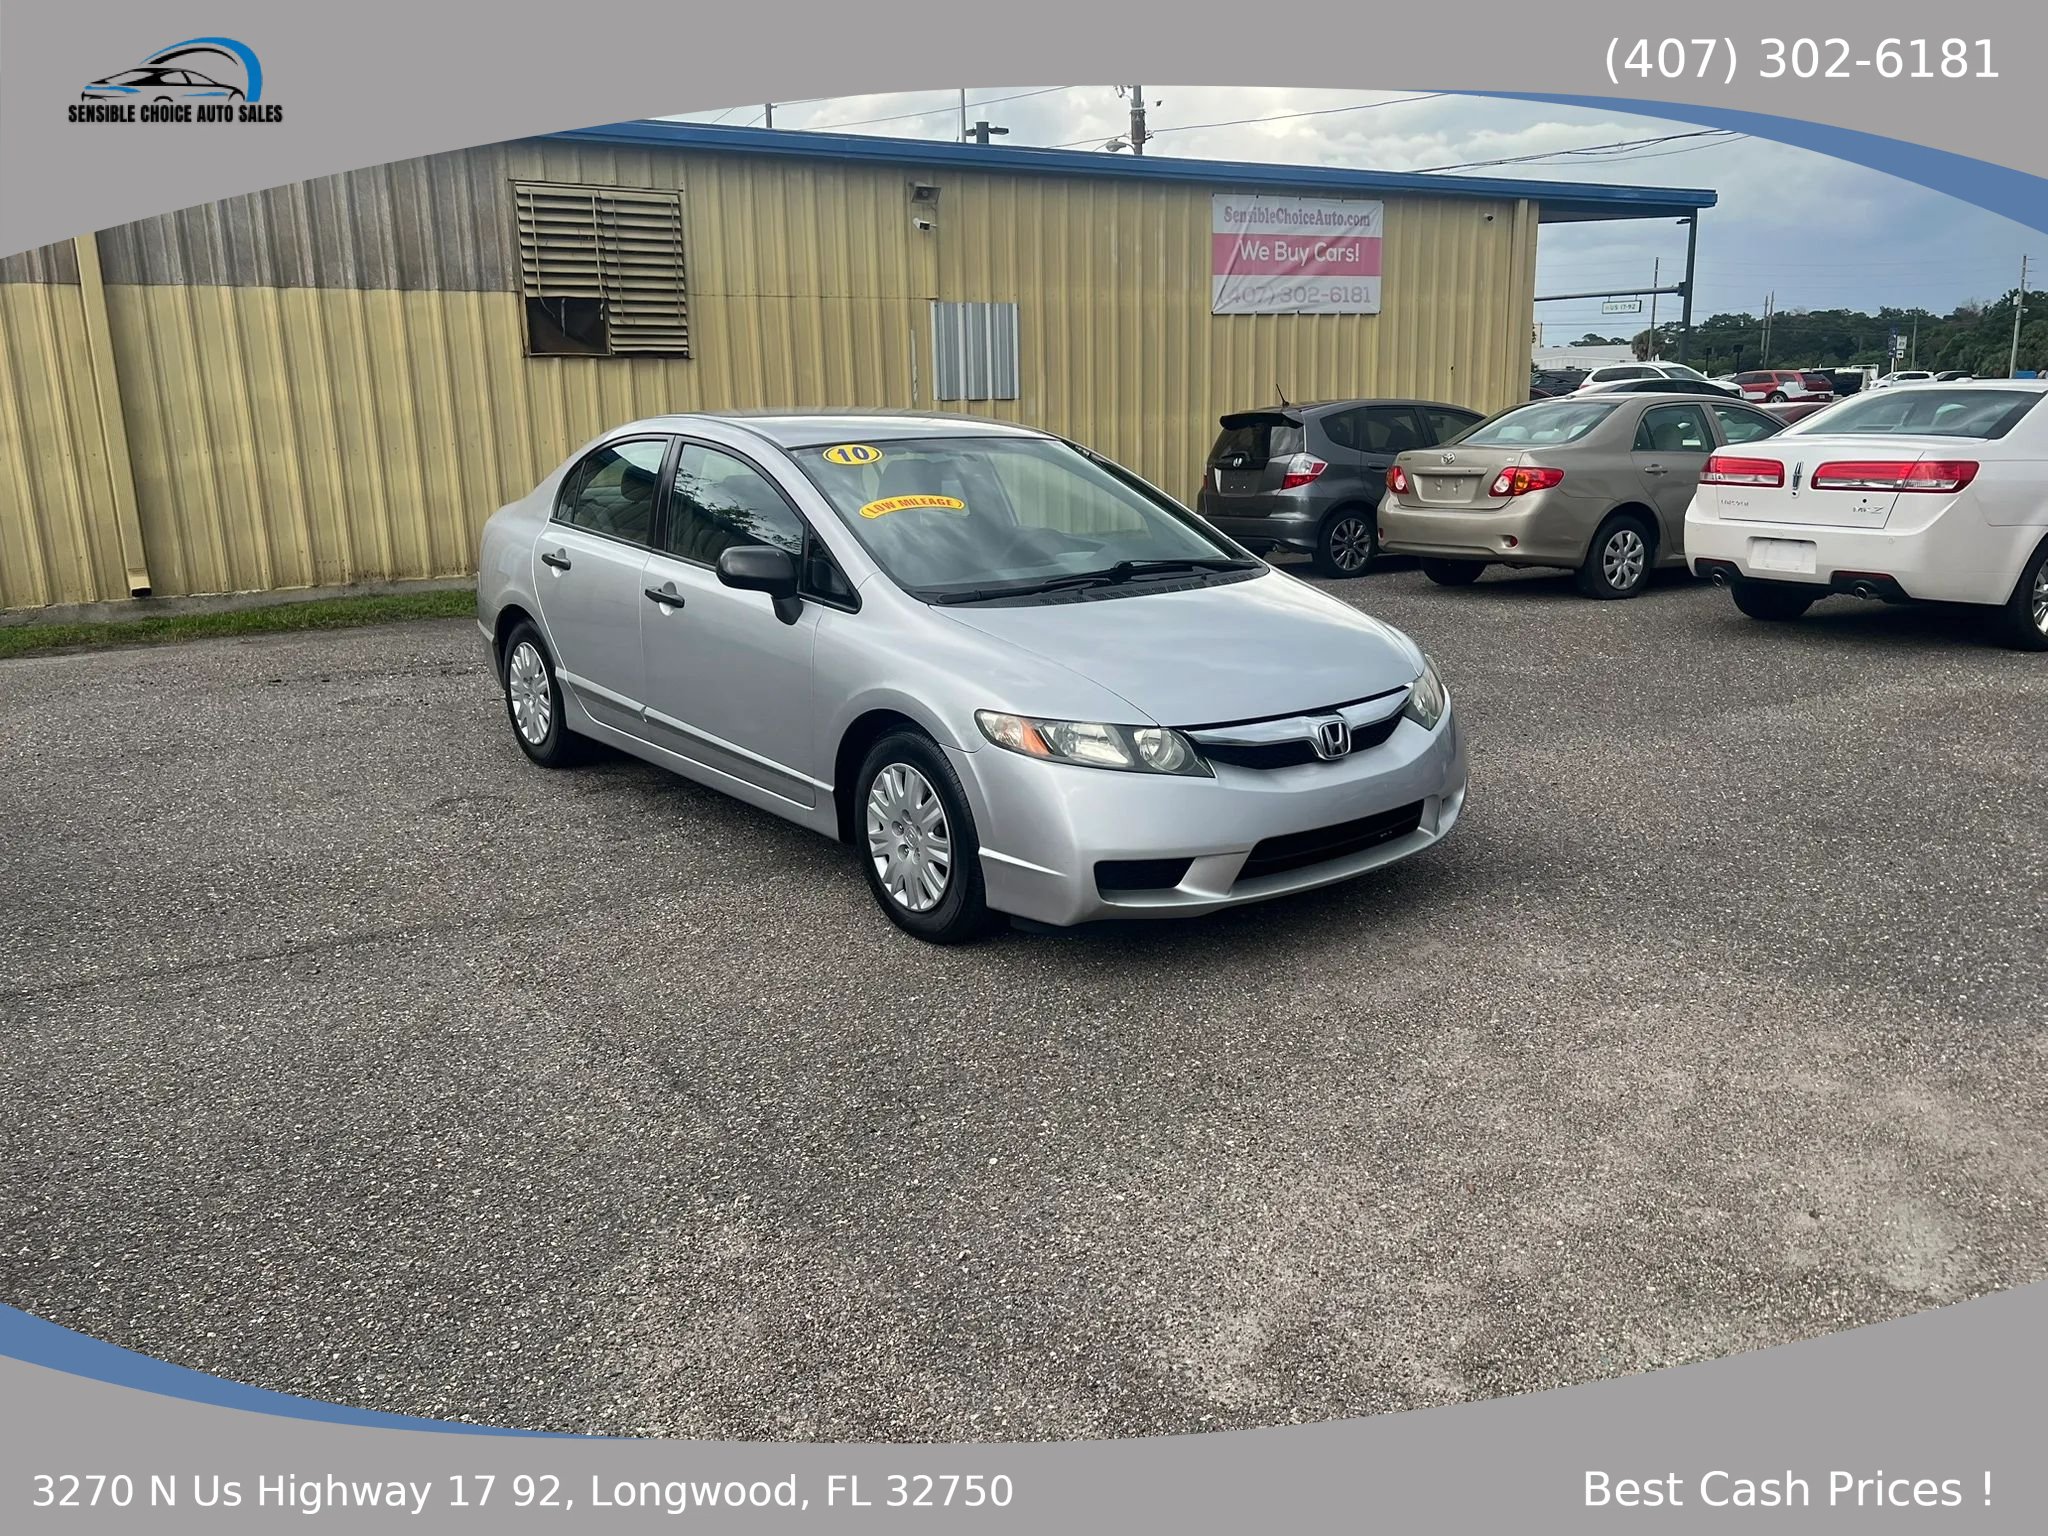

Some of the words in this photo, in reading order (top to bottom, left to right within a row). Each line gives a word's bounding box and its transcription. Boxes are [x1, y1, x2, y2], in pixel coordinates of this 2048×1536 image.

[1224, 206, 1371, 227] SensibleChoiceAuto.com
[1238, 239, 1270, 261] We
[1274, 240, 1310, 266] Buy
[1314, 241, 1360, 262] Cars!
[1279, 286, 1371, 304] 302-6181
[837, 447, 870, 462] 10
[868, 500, 895, 515] LOW
[897, 497, 954, 508] MILEAGE
